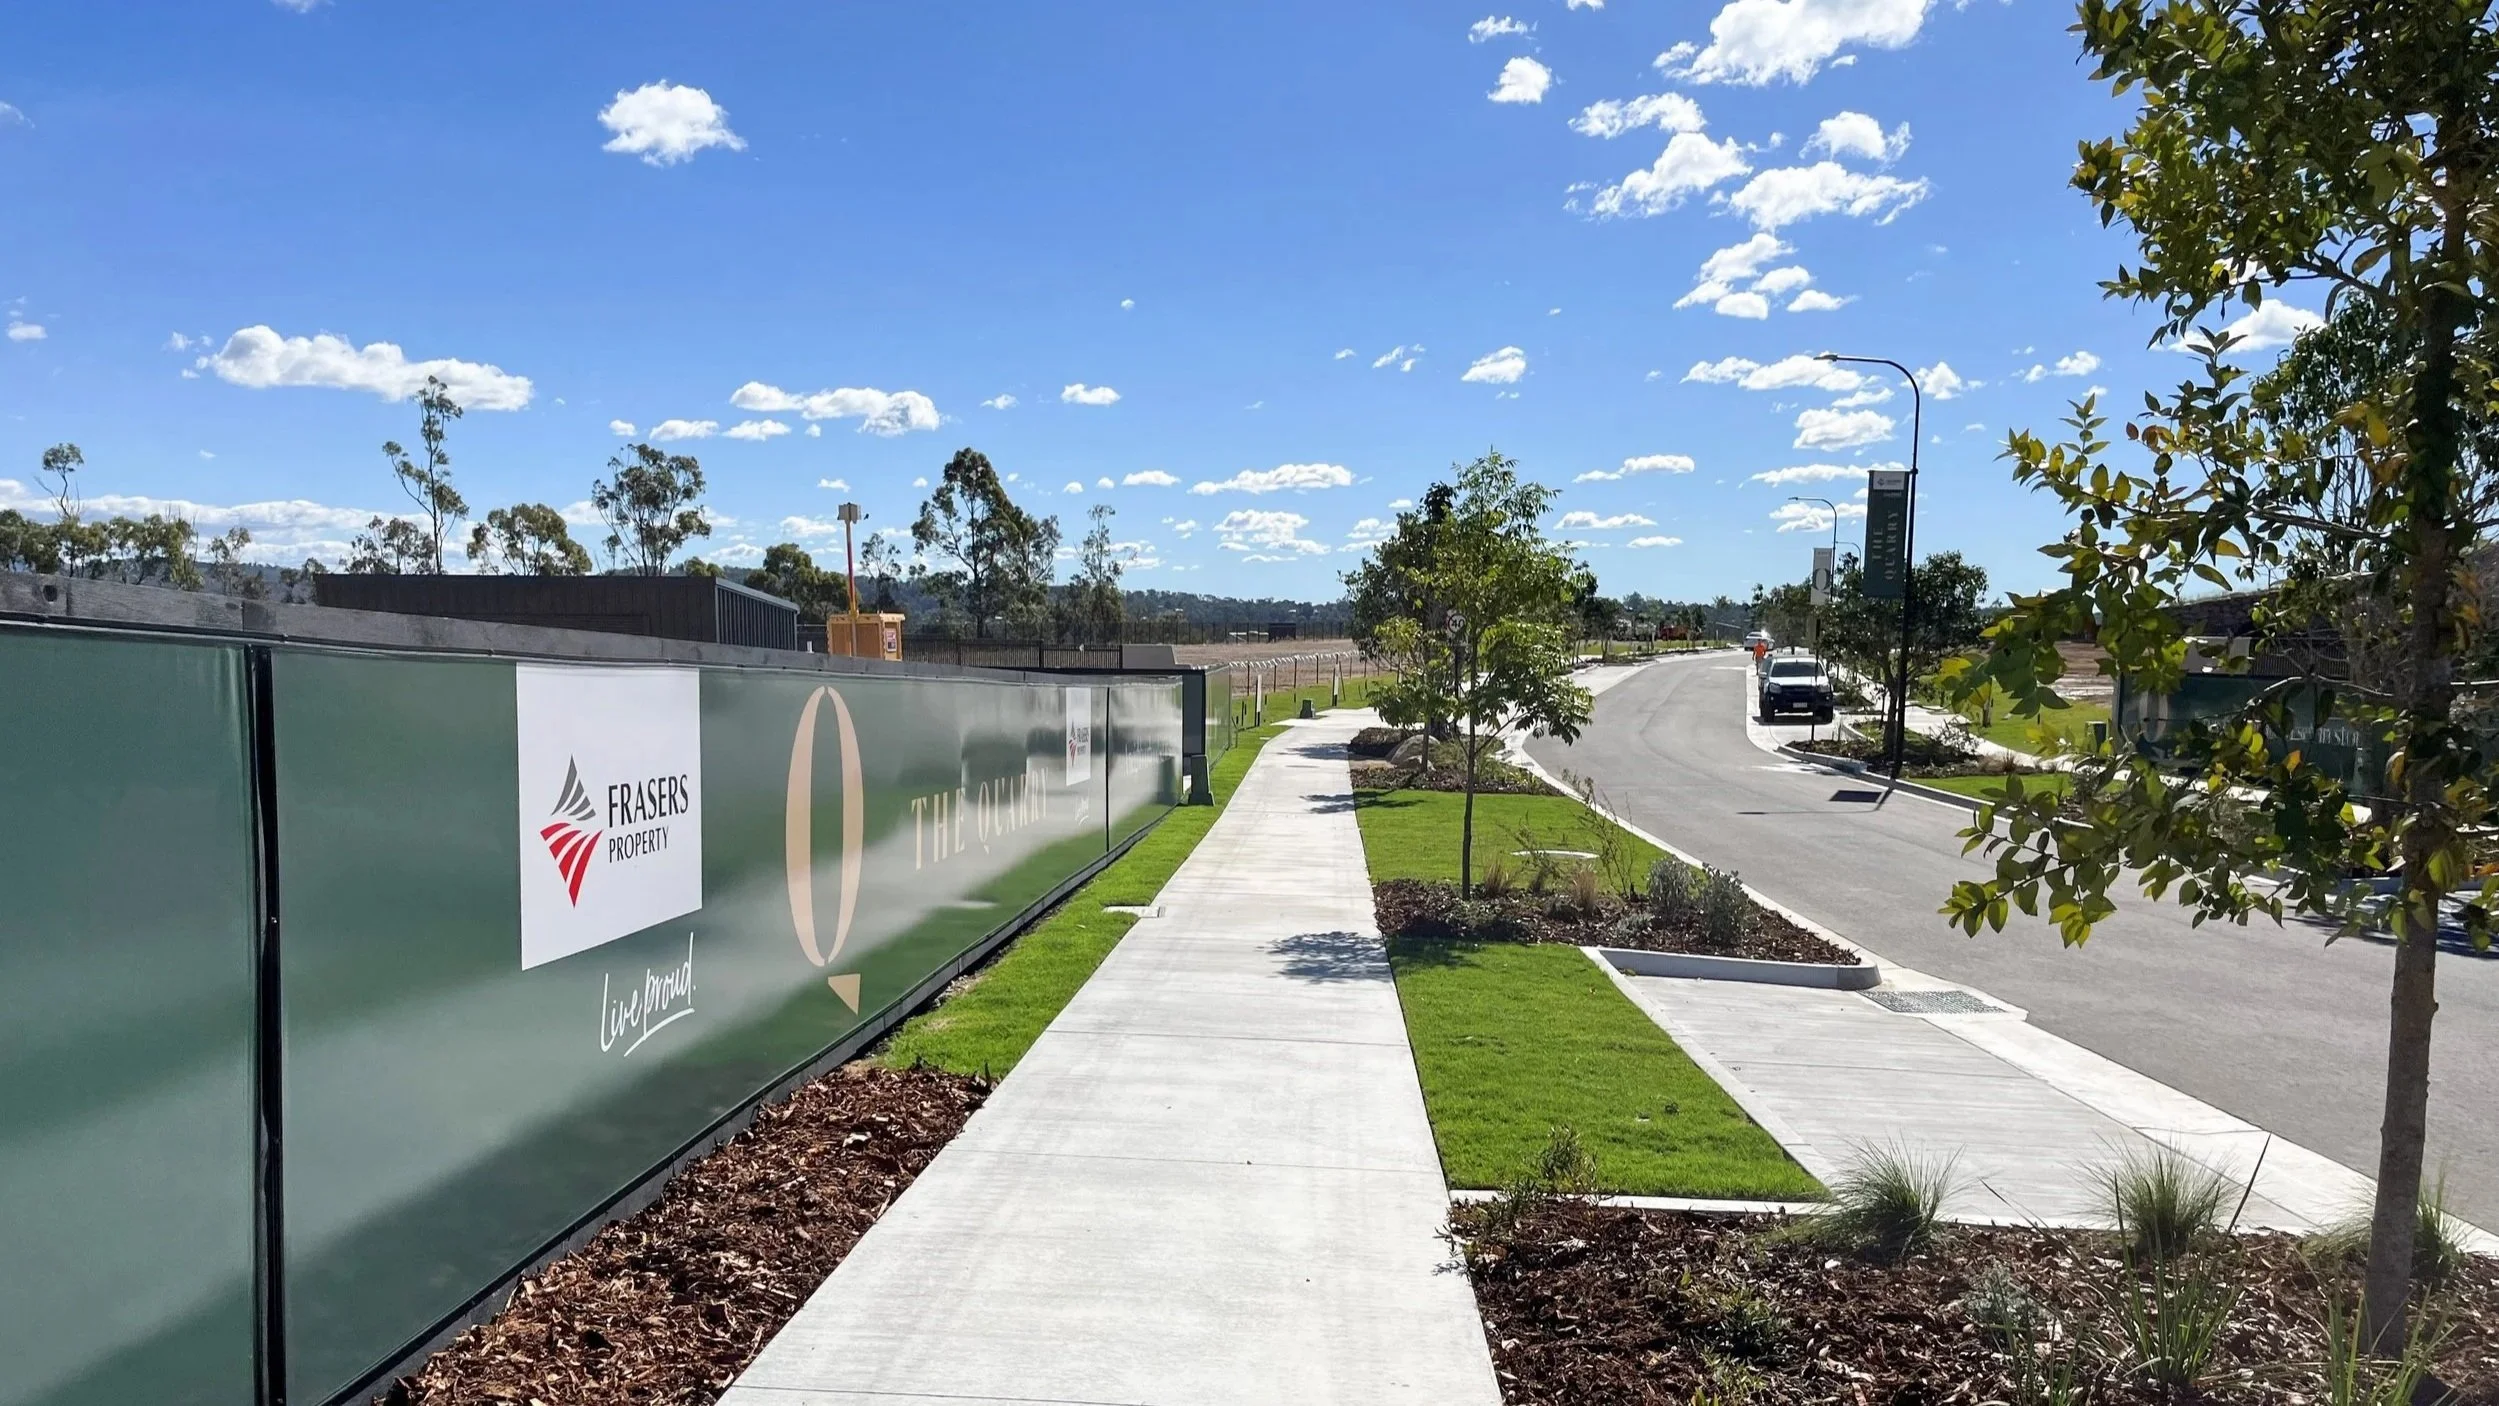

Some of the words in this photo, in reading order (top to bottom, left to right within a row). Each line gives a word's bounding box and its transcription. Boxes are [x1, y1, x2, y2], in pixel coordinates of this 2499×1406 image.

[1884, 510, 1899, 580] QUARRY
[608, 773, 689, 828] FRASERS
[911, 787, 966, 872] THE
[977, 766, 1049, 855] QUARRY
[608, 826, 670, 864] PROPERTY
